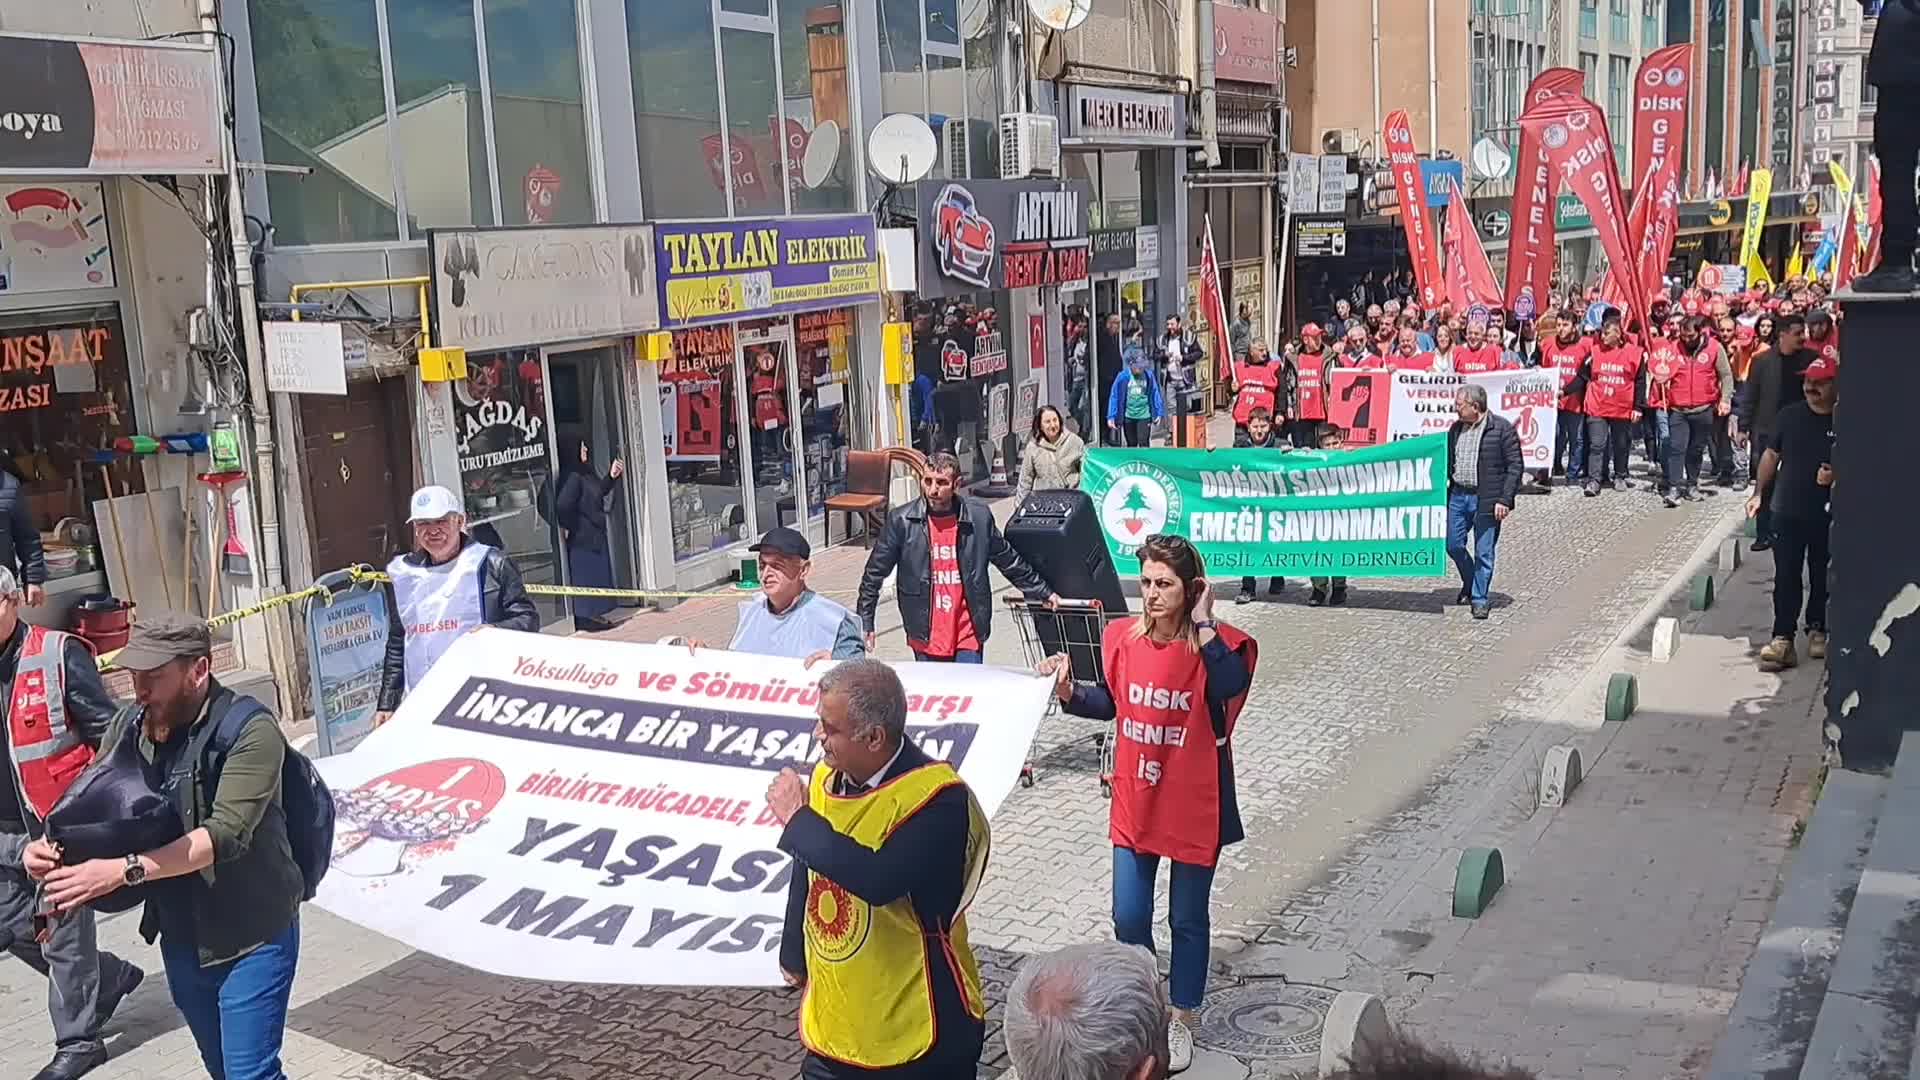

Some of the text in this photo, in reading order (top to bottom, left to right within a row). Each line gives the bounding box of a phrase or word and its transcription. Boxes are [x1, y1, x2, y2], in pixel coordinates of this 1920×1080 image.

[1639, 93, 1684, 111] DİSK
[1392, 151, 1416, 165] DİSK
[1016, 183, 1078, 240] ARTVİN
[664, 229, 867, 275] TAYLAN ELEKTRİK
[1004, 247, 1088, 289] RENT A CAR
[0, 328, 111, 374] NŞAAT
[678, 326, 733, 357] TAYLAN
[1407, 387, 1456, 399] VERGİ
[1422, 418, 1455, 428] ADA
[459, 443, 545, 473] URU TEMİZLEME
[1288, 457, 1433, 497] SAVUNMAK
[1190, 505, 1448, 542] EMEĞİ SAVUNMAKTIR
[1202, 549, 1437, 569] YEŞİL ARTVİN DERNEĞİ
[513, 656, 973, 721] Yoksulluğa ve Sömürü arşı
[1129, 682, 1192, 711] DİSK
[455, 683, 625, 741] İNSANCA
[625, 709, 699, 749] BİR
[437, 765, 475, 791] 1
[1138, 754, 1162, 786] İŞ
[516, 768, 622, 804] BİRLİKTE
[615, 782, 752, 826] MÜCADELE,
[507, 817, 794, 893] YAŞASI
[424, 873, 487, 910] 1
